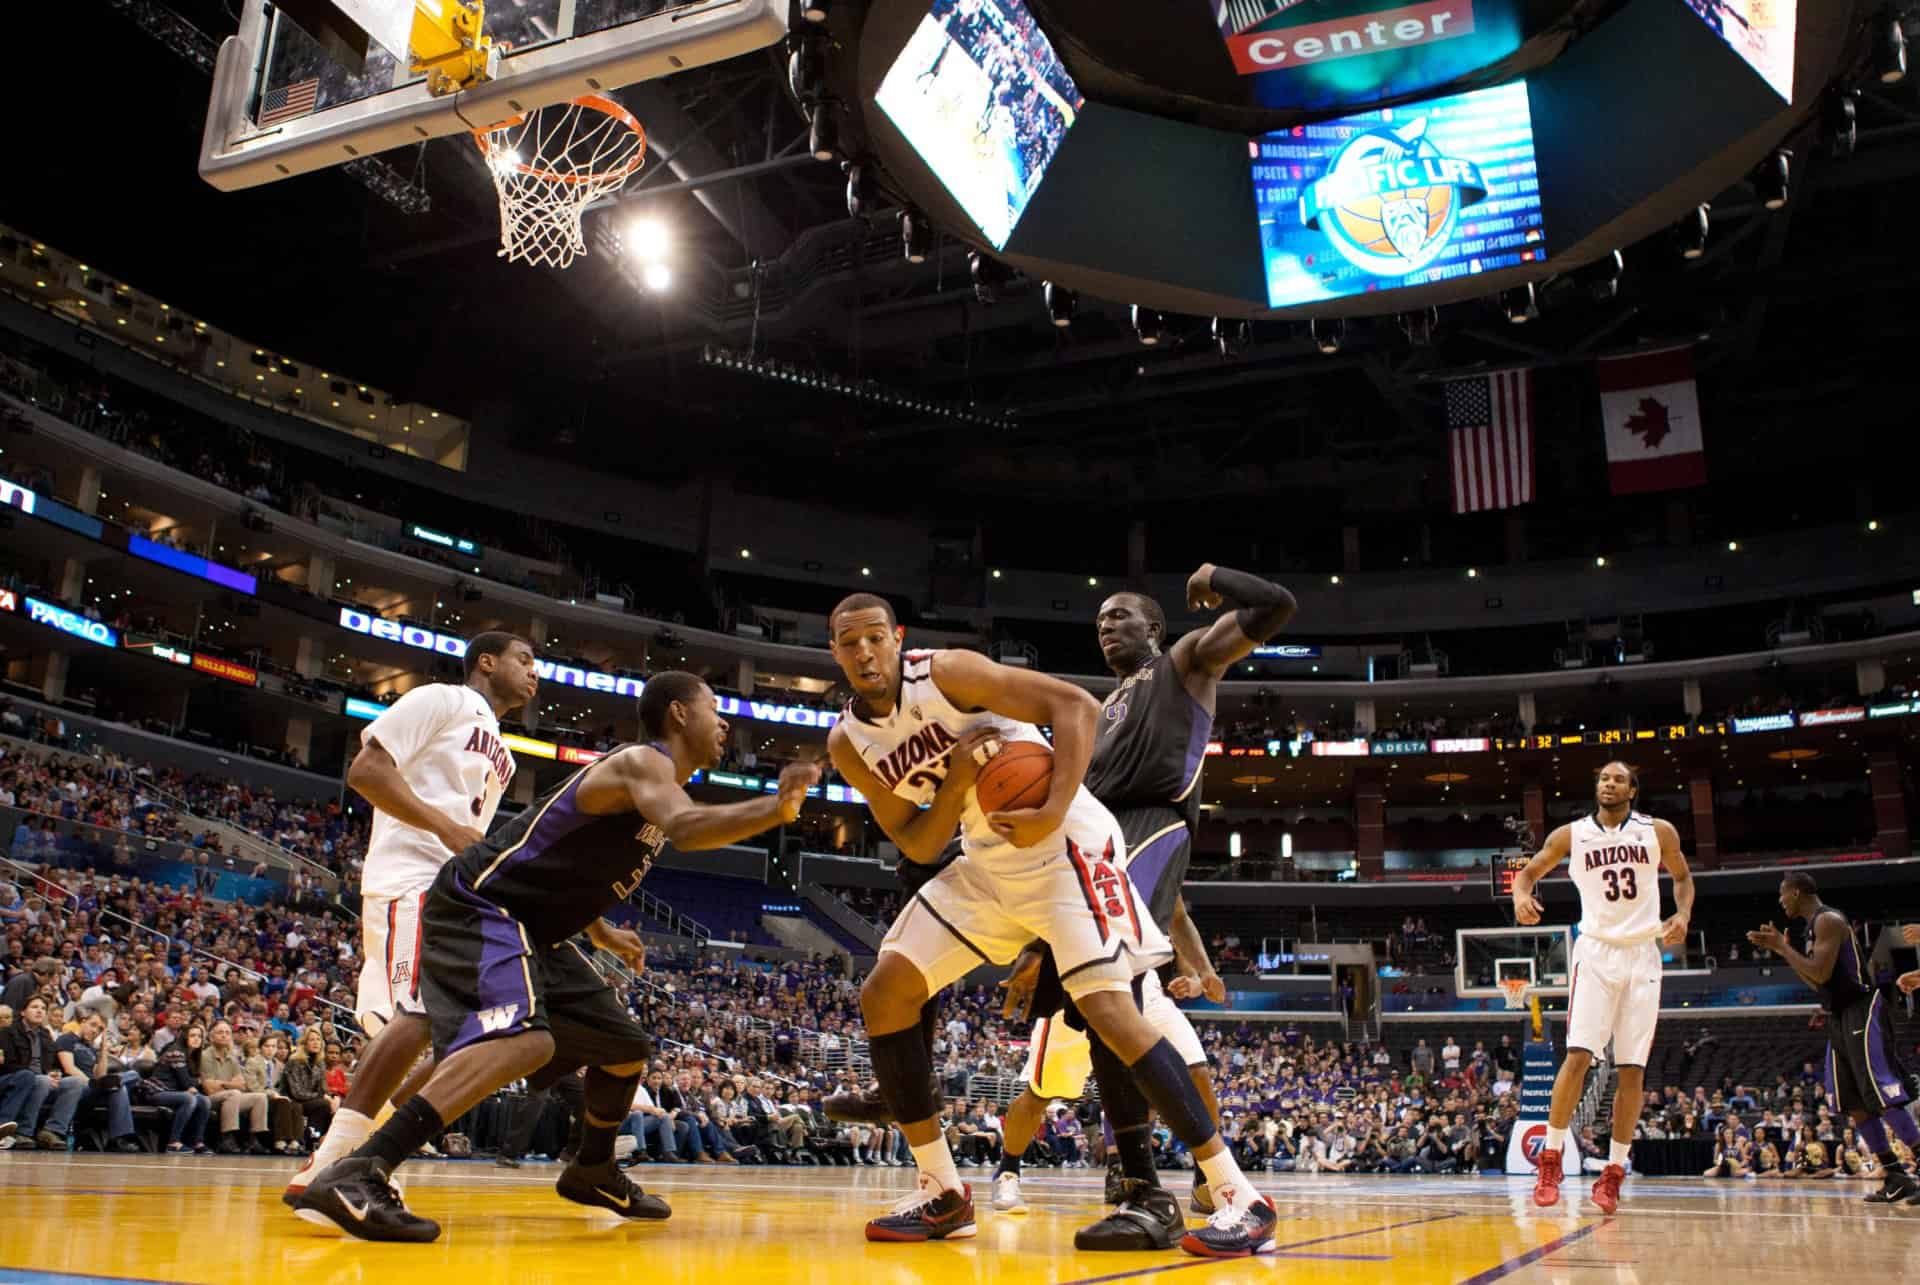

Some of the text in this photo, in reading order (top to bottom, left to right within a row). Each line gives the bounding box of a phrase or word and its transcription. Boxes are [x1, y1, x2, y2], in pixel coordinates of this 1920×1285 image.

[1248, 11, 1452, 65] Center
[1386, 742, 1428, 753] DELTA
[1584, 845, 1650, 872] ARIZONA
[1083, 849, 1126, 918] ATS
[1602, 867, 1638, 902] 33
[477, 1003, 519, 1034] W
